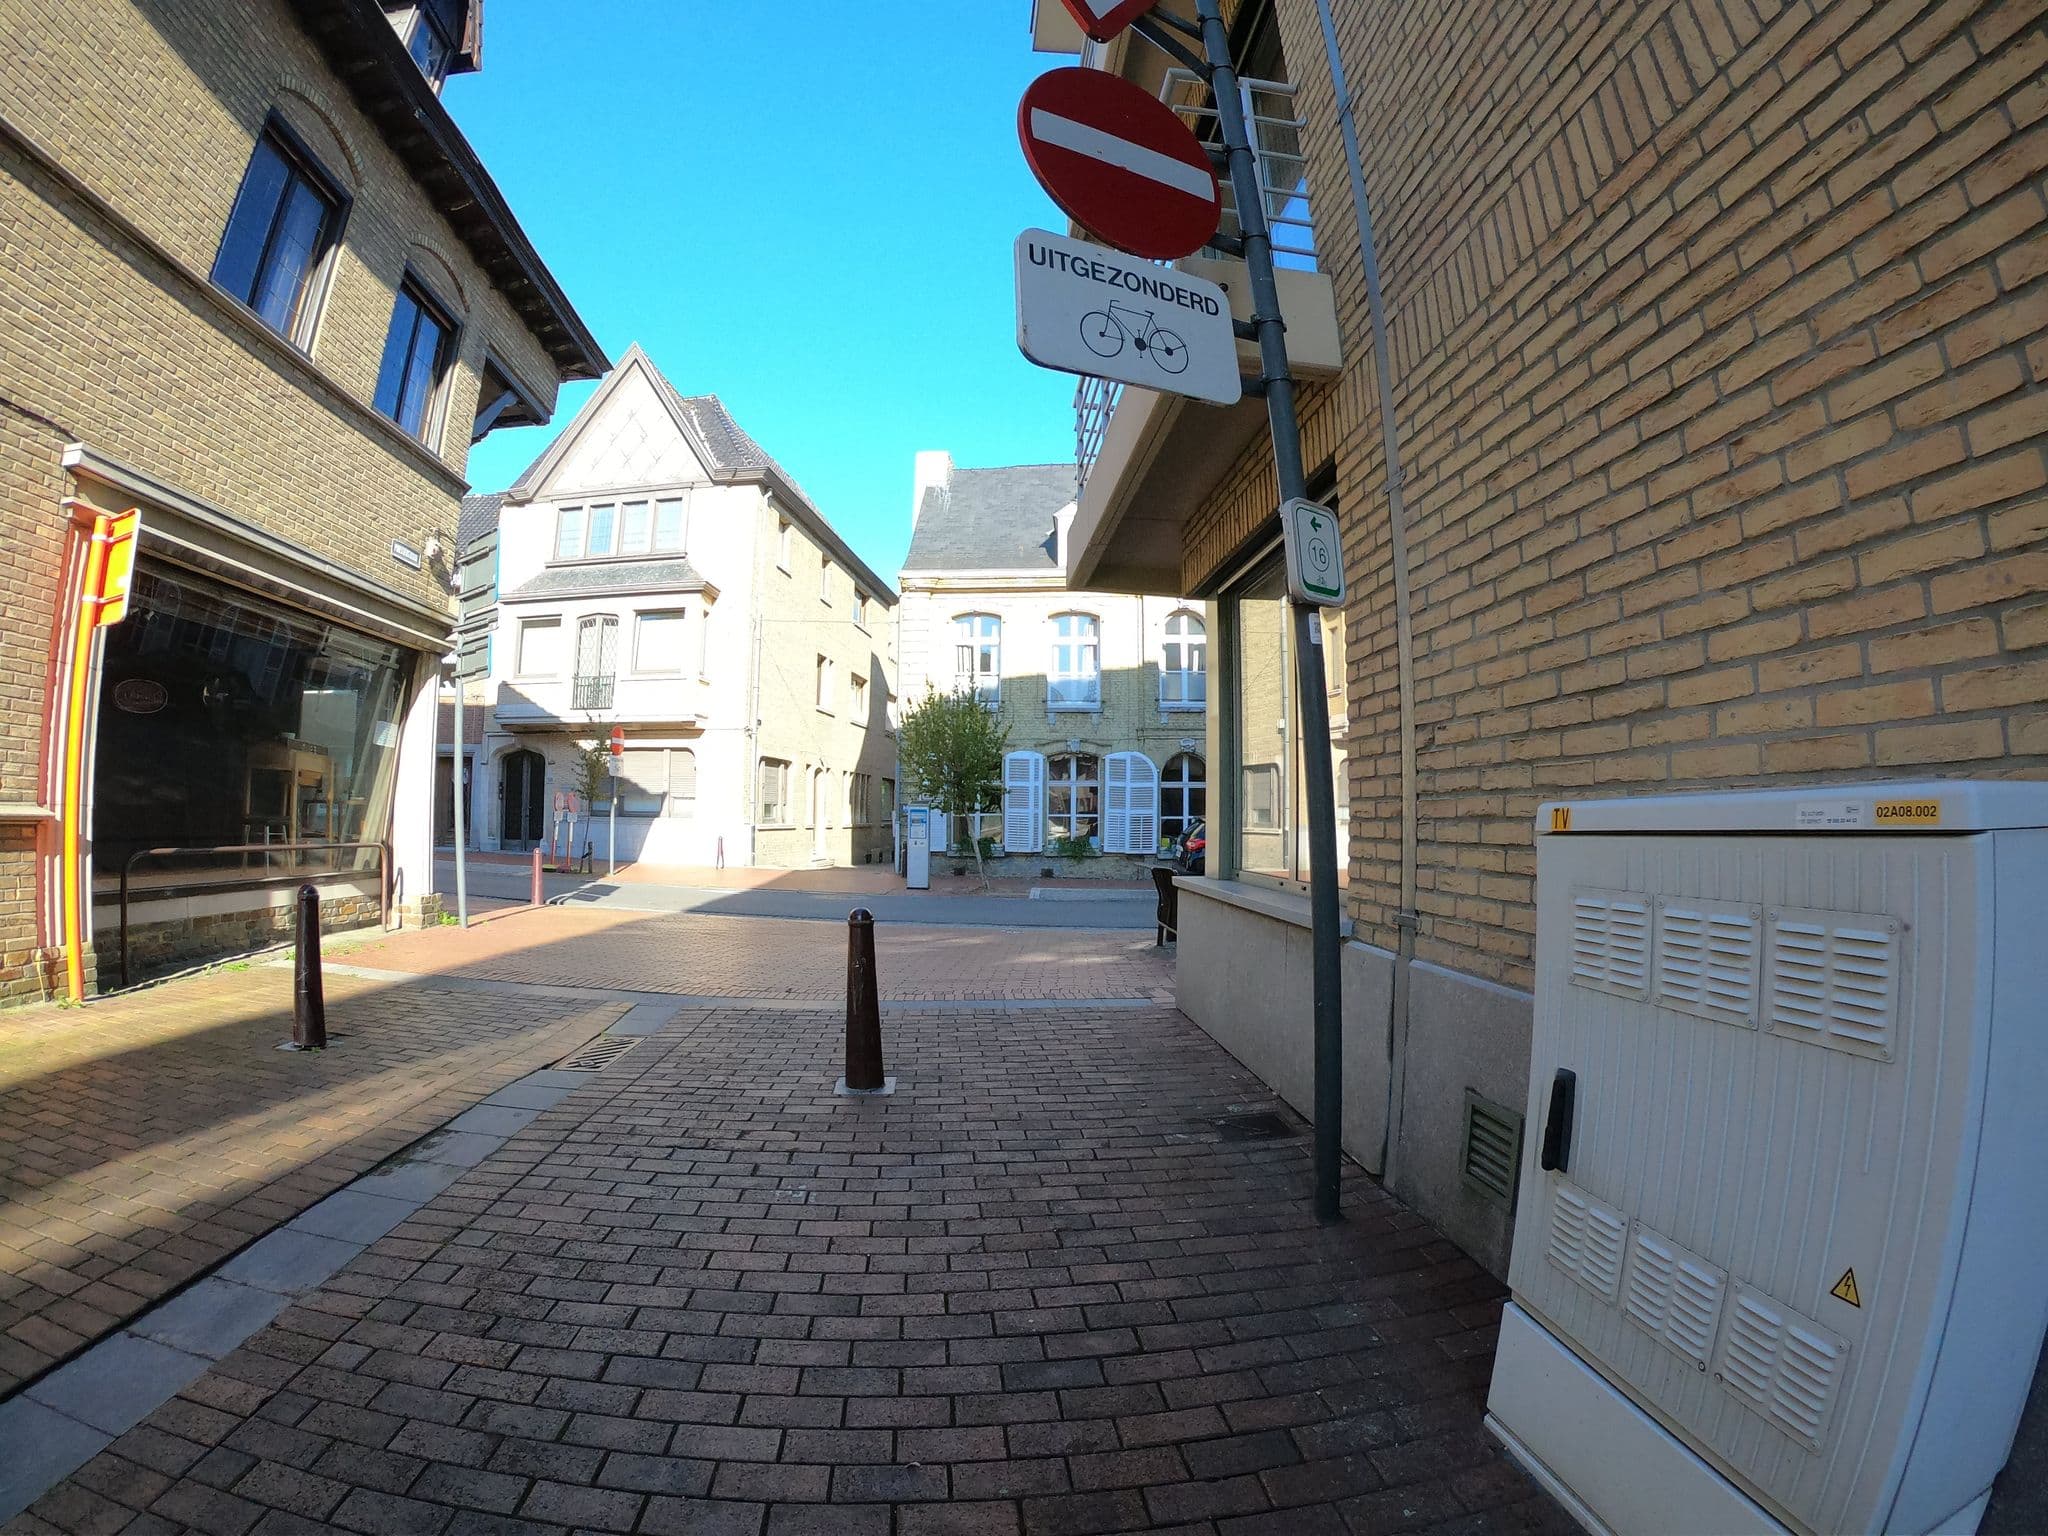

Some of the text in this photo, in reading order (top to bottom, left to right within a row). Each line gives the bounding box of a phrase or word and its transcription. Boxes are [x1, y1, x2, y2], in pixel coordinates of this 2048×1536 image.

[1029, 243, 1219, 316] UITGEZONDERD
[1312, 545, 1327, 565] 16
[1553, 807, 1570, 830] TV
[1876, 805, 1937, 818] 02A08.002
